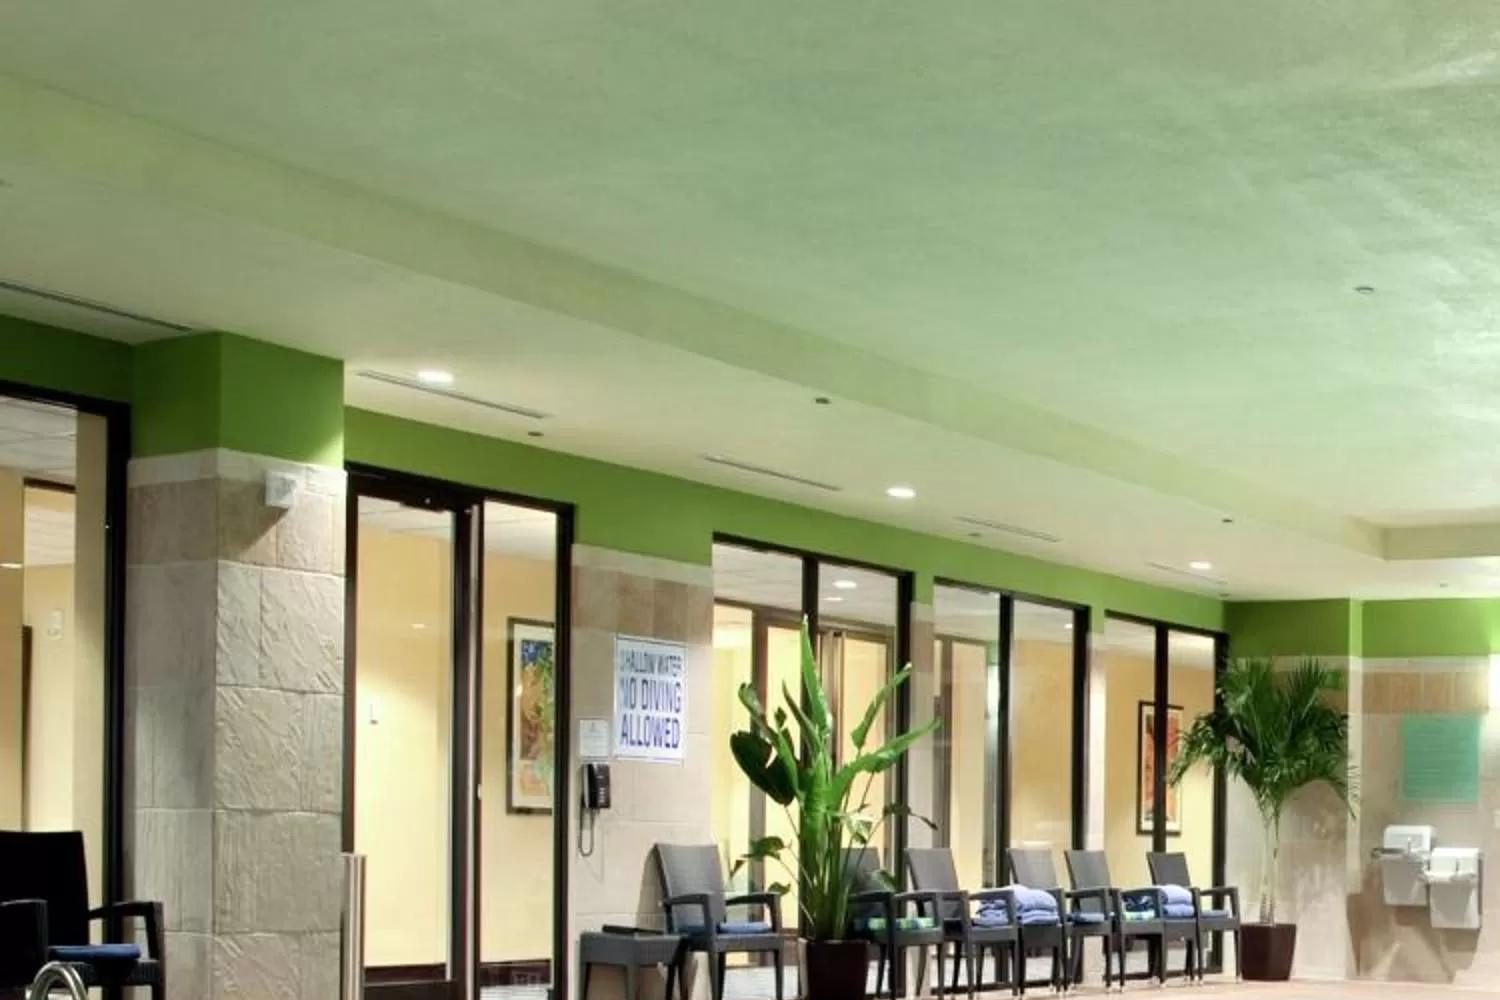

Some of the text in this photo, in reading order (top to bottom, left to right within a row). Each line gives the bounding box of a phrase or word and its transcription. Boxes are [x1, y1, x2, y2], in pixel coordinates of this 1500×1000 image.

[620, 677, 682, 713] NO DIVING
[620, 713, 681, 748] ALLOWED
